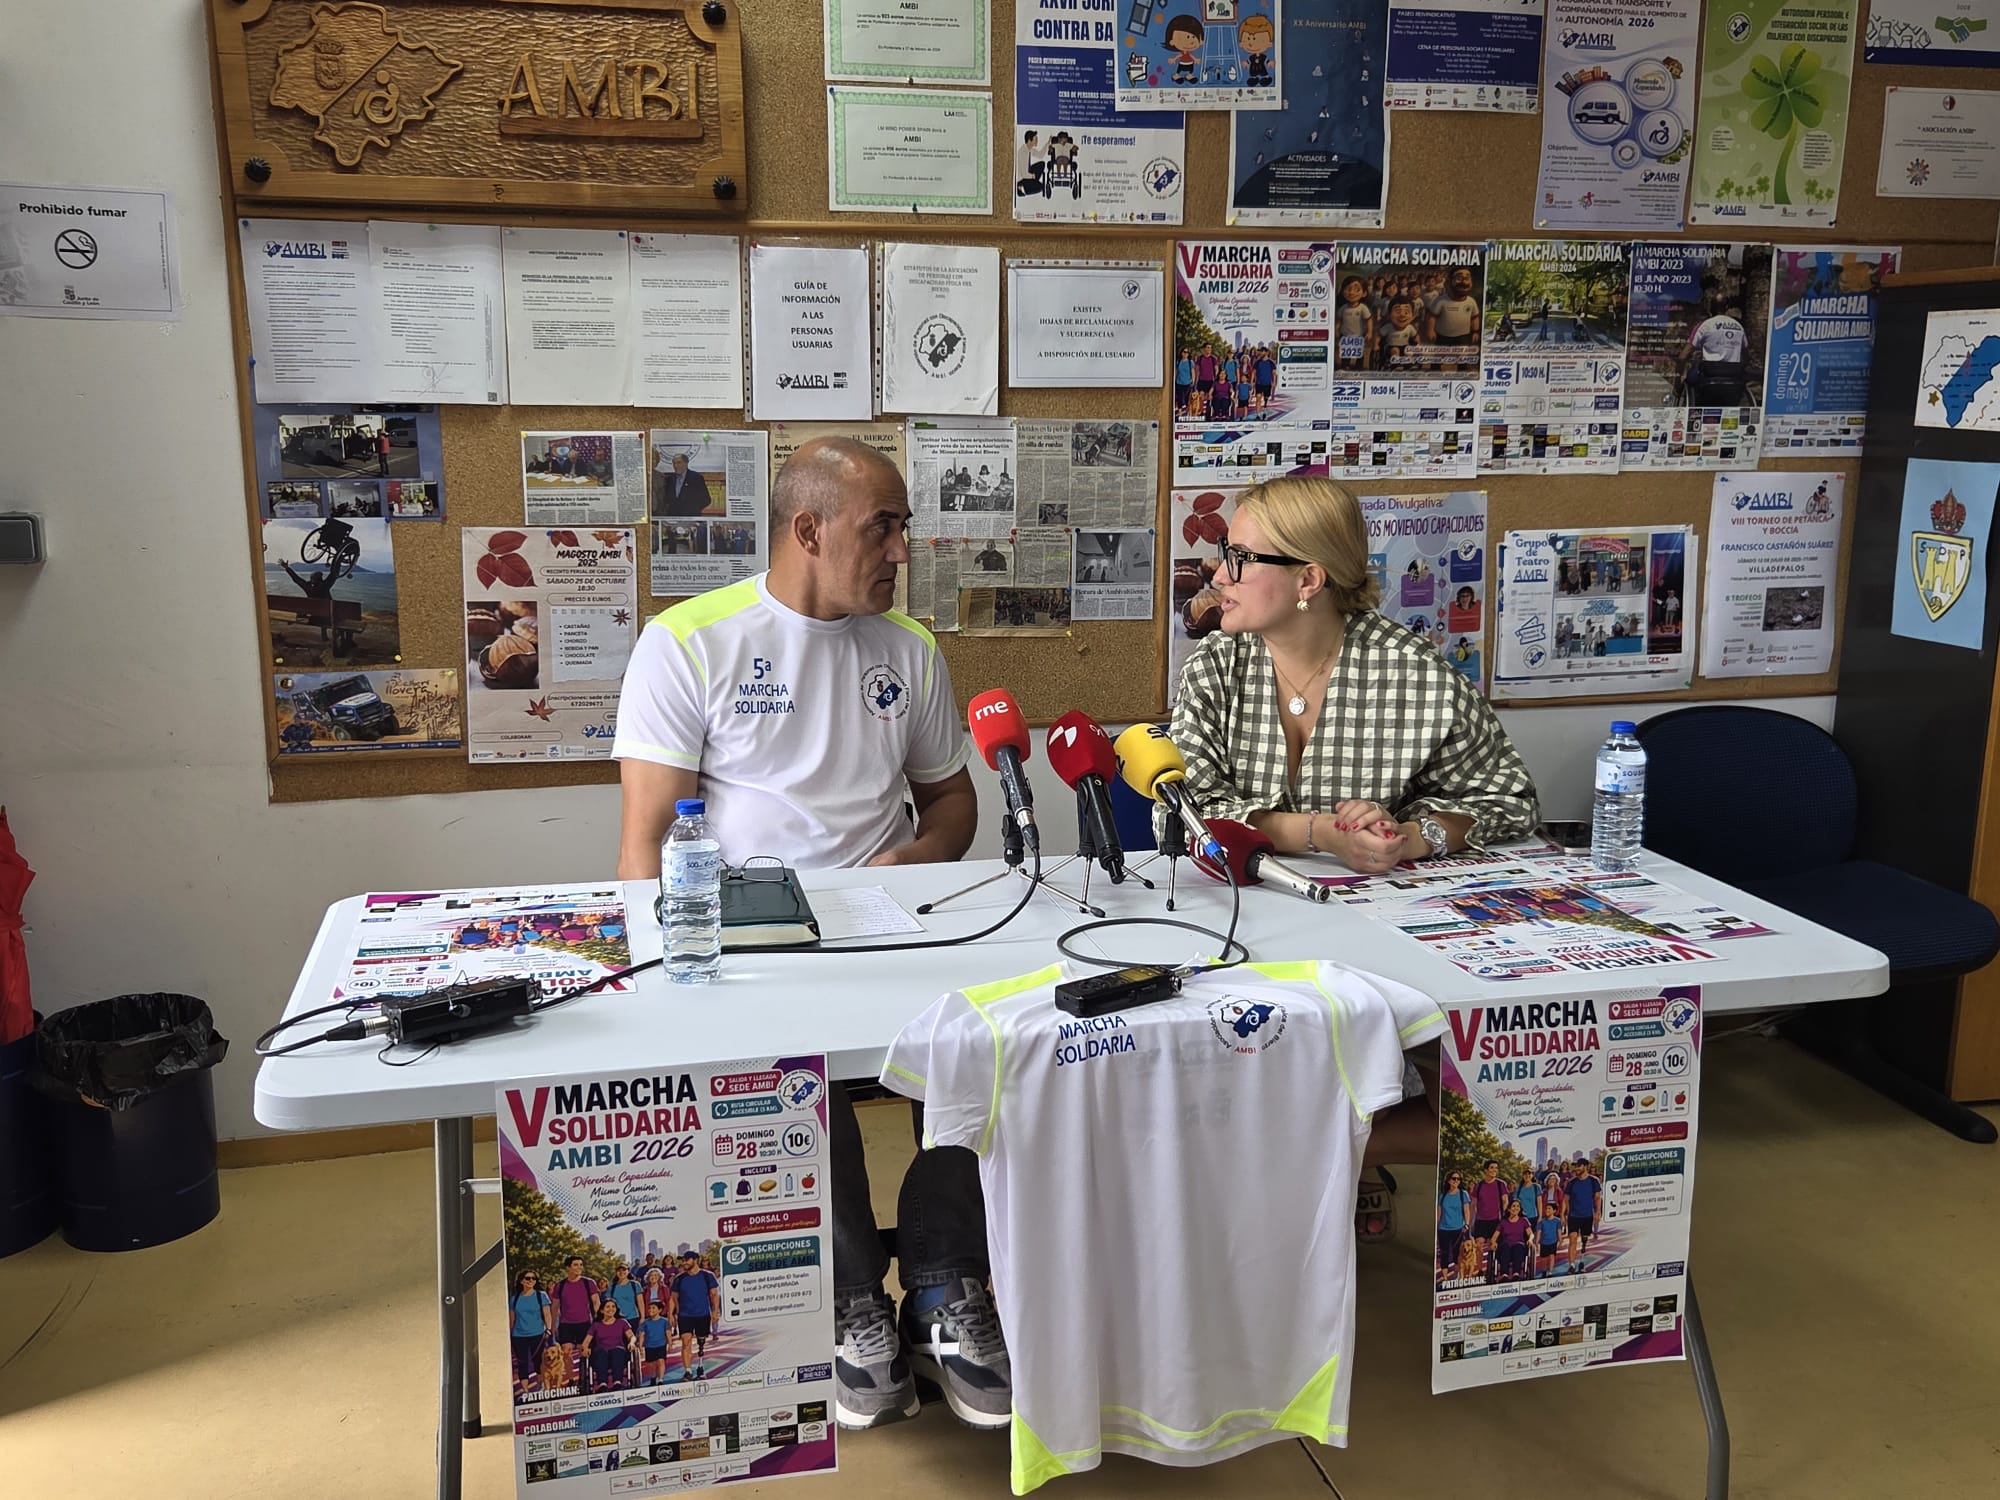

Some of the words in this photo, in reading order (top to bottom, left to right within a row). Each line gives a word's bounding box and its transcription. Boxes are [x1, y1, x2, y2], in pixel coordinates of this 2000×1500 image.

[900, 2, 918, 10] AMBI
[1293, 20, 1303, 28] XX
[1305, 20, 1347, 29] Aniversario
[1348, 21, 1366, 30] AMBI
[1565, 14, 1623, 26] AUTONOMÍA
[1628, 17, 1654, 28] 2026
[1034, 19, 1089, 40] CONTRA
[1580, 33, 1614, 47] AMBI
[502, 52, 700, 121] AMBI
[1093, 136, 1135, 146] esperamos!
[1287, 155, 1326, 163] ACTIVIDADES
[1654, 173, 1680, 182] AMBI
[19, 203, 83, 215] Prohibido
[87, 206, 127, 218] fumar
[282, 242, 326, 257] AMBI
[1490, 246, 1503, 261] III
[1505, 245, 1558, 261] MARCHA
[1560, 246, 1622, 262] SOLIDARIA
[1644, 247, 1680, 258] MARCHA
[1682, 248, 1726, 258] SOLIDARIA
[1181, 246, 1202, 278] V
[1203, 246, 1271, 262] MARCHA
[1336, 249, 1349, 264] IV
[1352, 249, 1408, 265] MARCHA
[1412, 249, 1480, 266] SOLIDARIA
[1200, 264, 1273, 279] SOLIDARIA
[1539, 264, 1557, 273] AMBI
[1559, 263, 1576, 273] 2024
[1636, 260, 1659, 269] AMBI
[1661, 260, 1683, 270] 2023
[794, 280, 815, 290] GUÍA
[1644, 275, 1669, 283] JUNIO
[1672, 276, 1692, 284] 2023
[1199, 281, 1233, 293] AMBI
[1237, 281, 1269, 293] 2026
[782, 295, 840, 304] INFORMACIÓN
[1810, 296, 1868, 314] MARCHA
[1794, 321, 1848, 340] SOLIDARIA
[1850, 322, 1871, 336] AMBI
[1044, 350, 1088, 358] DISPOSICIÓN
[1340, 348, 1362, 358] 2025
[1484, 368, 1512, 380] 16
[1788, 352, 1811, 386] 29
[792, 374, 828, 386] AMBI
[1774, 353, 1792, 399] domingo
[1332, 387, 1360, 396] 22
[1787, 387, 1808, 403] mayo
[1388, 497, 1442, 512] Divulgativa
[1750, 493, 1793, 507] AMBI
[1384, 519, 1429, 537] MOVIENDO
[1430, 515, 1484, 533] CAPACIDADES
[1747, 517, 1780, 525] TORNEO
[1794, 515, 1828, 524] PETANCA
[1515, 539, 1547, 549] Grupo
[1721, 542, 1764, 551] FRANCISCO
[1766, 541, 1806, 550] CASTAÑÓN
[1808, 540, 1834, 549] SUÁREZ
[557, 550, 597, 559] MAGOSTO
[599, 551, 621, 559] AMBI
[578, 559, 598, 567] 2025
[1515, 557, 1549, 566] Teatro
[671, 564, 678, 572] de
[679, 564, 696, 572] todos
[707, 566, 720, 574] que
[1515, 569, 1548, 580] AMBI
[1749, 565, 1805, 573] VILLADEPALOS
[739, 683, 789, 697] MARCHA
[735, 700, 795, 714] SOLIDARIA
[975, 700, 1008, 721] rne
[1597, 939, 1652, 949] AMBI
[1553, 946, 1664, 961] SOLIDARIA
[1570, 953, 1683, 970] MARCHA
[1058, 1014, 1127, 1041] MARCHA
[1448, 1007, 1483, 1061] V
[1486, 1000, 1598, 1033] MARCHA
[1055, 1034, 1137, 1067] SOLIDARIA
[1234, 1046, 1256, 1054] AMBI
[1479, 1028, 1600, 1060] SOLIDARIA
[1627, 1051, 1657, 1059] DOMINGO
[1477, 1061, 1535, 1083] AMBI
[1541, 1055, 1593, 1078] 2026
[1626, 1062, 1642, 1076] 28
[729, 1083, 751, 1092] SEDE
[752, 1081, 773, 1090] AMBI
[506, 1087, 550, 1147] V
[554, 1074, 697, 1115] MARCHA
[548, 1105, 702, 1145] SOLIDARIA
[736, 1129, 774, 1140] DOMINGO
[788, 1133, 810, 1147] 10€
[547, 1144, 622, 1171] AMBI
[630, 1135, 694, 1164] 2026
[736, 1142, 757, 1159] 28
[1627, 1151, 1678, 1161] INSCRIPCIONES
[745, 1166, 772, 1174] INCLUYE
[572, 1175, 615, 1188] Diferentes
[590, 1187, 620, 1198] Mismo
[591, 1199, 620, 1210] Mismo
[581, 1213, 598, 1223] Una
[602, 1208, 638, 1221] Sociedad
[640, 1204, 676, 1216] Inclusiva
[750, 1214, 780, 1224] DORSAL
[748, 1240, 811, 1253] INSCRIPCIONES
[522, 1385, 580, 1403] PATROCINAN:
[590, 1398, 621, 1408] COSMOS
[524, 1419, 579, 1435] COLABORAN:
